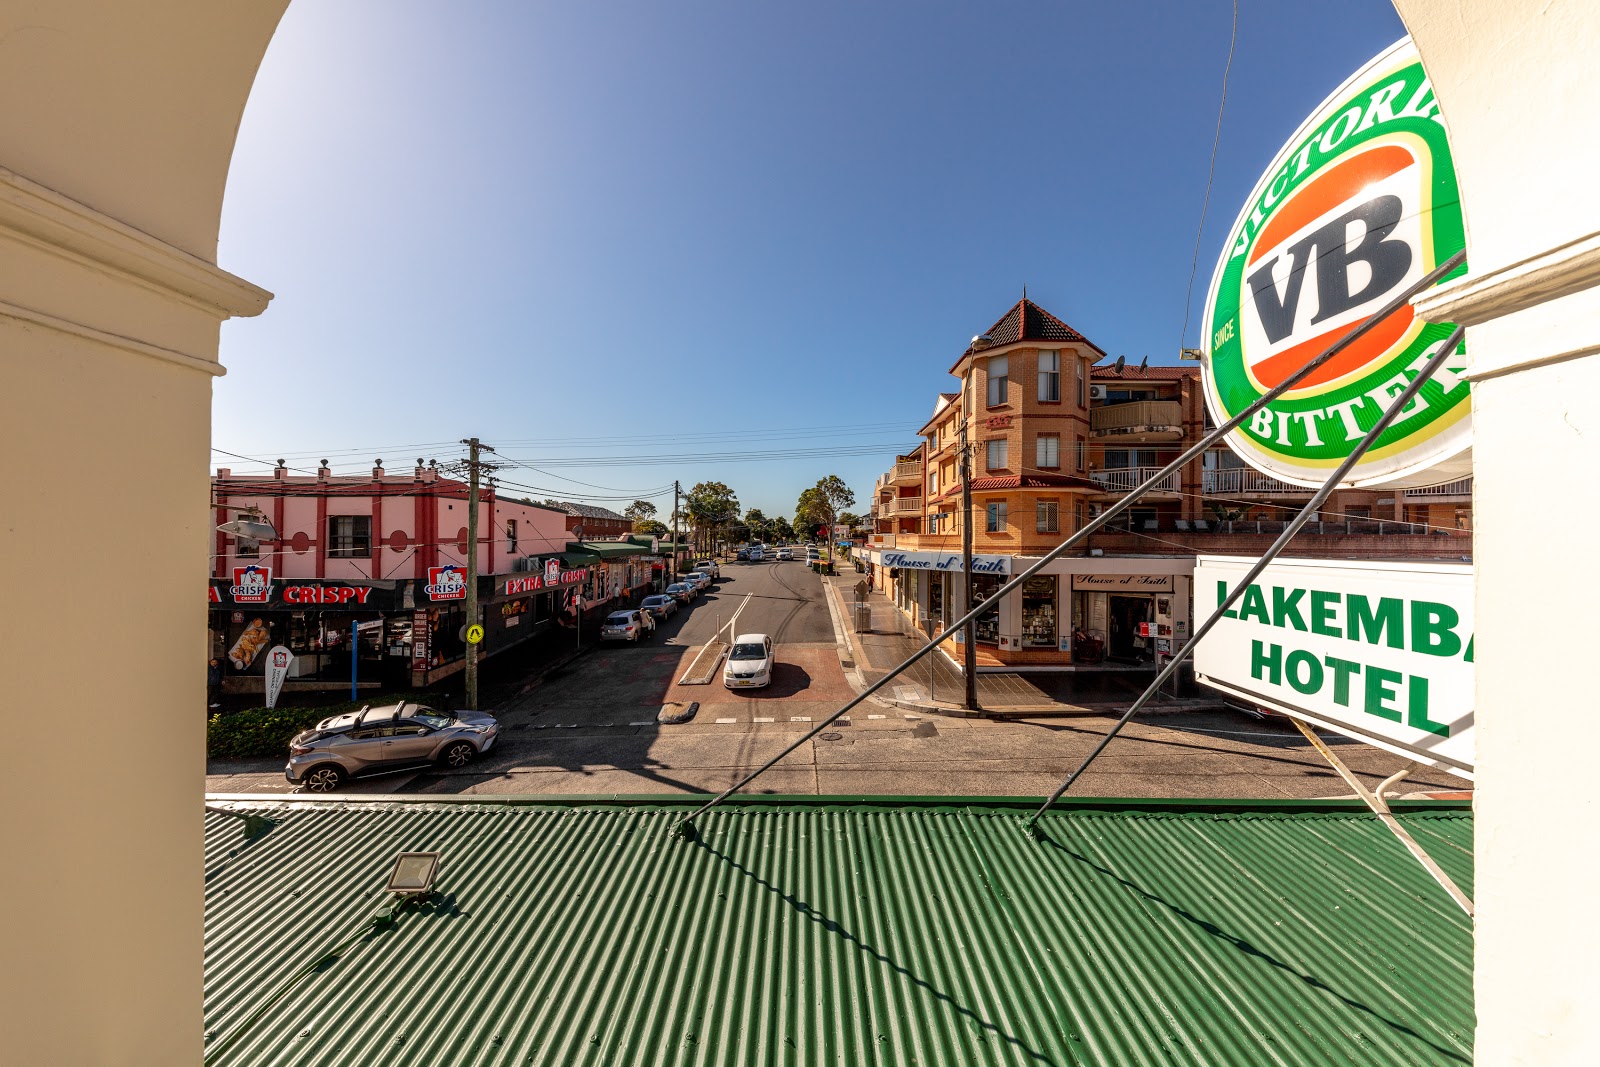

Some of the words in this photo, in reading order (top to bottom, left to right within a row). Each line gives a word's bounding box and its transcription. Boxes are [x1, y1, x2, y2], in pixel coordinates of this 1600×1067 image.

[1247, 193, 1412, 344] VB
[1215, 318, 1234, 350] SINCE
[884, 553, 931, 568] House
[936, 556, 958, 569] of
[230, 585, 272, 595] CRISPY
[506, 576, 542, 595] EXTRA
[561, 569, 587, 584] CRISPY
[1077, 574, 1115, 584] House
[1120, 576, 1136, 585] of
[1137, 575, 1167, 585] Faith
[283, 586, 372, 604] CRISPY
[1217, 580, 1474, 663] LAKEMB
[1251, 639, 1450, 738] HOTEL
